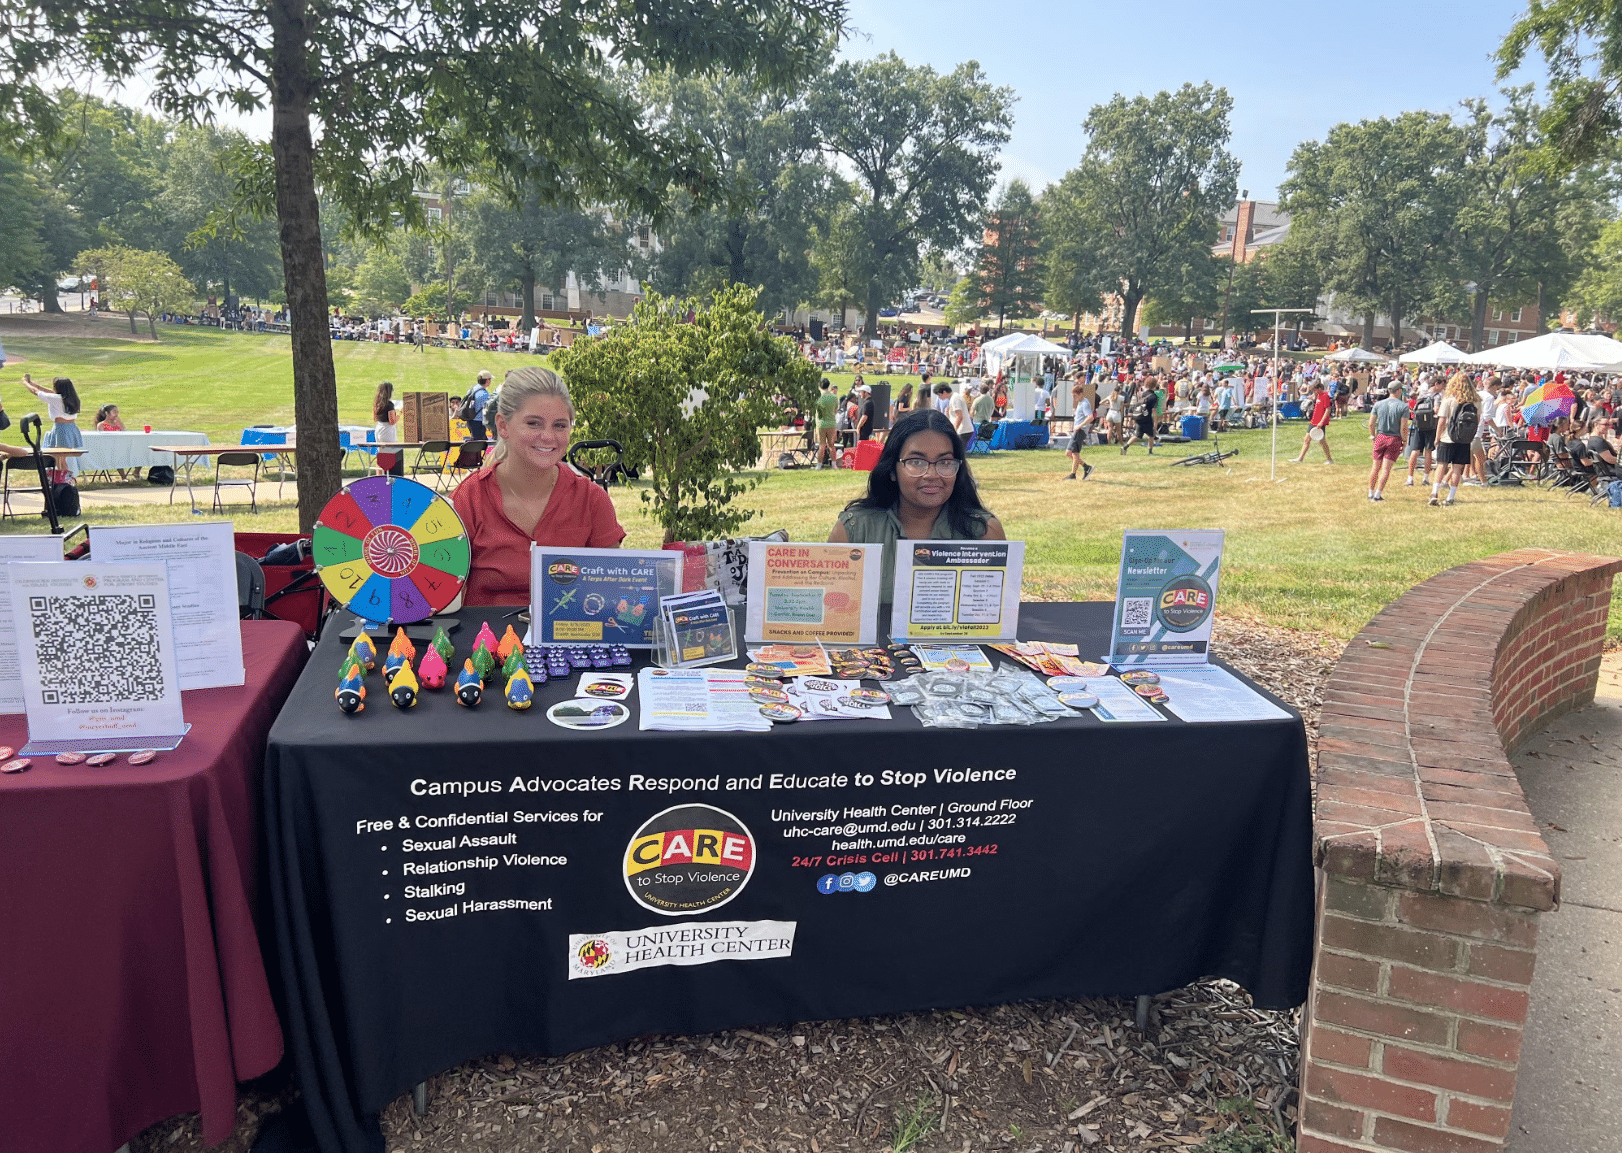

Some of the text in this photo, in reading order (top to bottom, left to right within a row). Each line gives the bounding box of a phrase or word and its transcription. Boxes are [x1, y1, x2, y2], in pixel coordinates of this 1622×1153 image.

[335, 511, 356, 528] 2
[426, 519, 443, 535] 5
[768, 548, 810, 557] CARE IN
[550, 564, 578, 573] CARE
[581, 566, 604, 574] Craft
[607, 567, 628, 575] with
[767, 559, 850, 569] CONVERSATION
[1128, 566, 1168, 575] Newsletter
[400, 590, 414, 609] 8
[1162, 590, 1208, 604] CARE
[411, 768, 1016, 797] Campus Advocates Respond and Educate to Stop Violence
[771, 809, 840, 822] University
[843, 806, 886, 819] Health
[891, 805, 936, 816] Center
[948, 800, 996, 813] Ground
[1000, 799, 1033, 810] Floor
[357, 810, 604, 834] Free & Confidential Services for
[783, 820, 916, 838] uhc-care@umd.edu
[926, 812, 1016, 829] 301.314.2222
[402, 833, 517, 852] Sexual Assault
[633, 834, 746, 864] CARE
[832, 834, 966, 850] health.umd.edu/care
[404, 854, 567, 875] Relationship Violence
[792, 855, 822, 868] 24/7
[826, 854, 867, 866] Crisis
[910, 844, 998, 861] 301.741.3442
[637, 872, 739, 886] to Stop Violence
[884, 868, 971, 886] @CAREUMD
[404, 882, 465, 898] Stalking
[644, 887, 732, 908] UNIVERSITY HEALTH CENTER
[406, 898, 552, 922] Sexual Harassment
[626, 926, 750, 949] UNIVERSITY
[625, 938, 791, 964] HEALTH CENTER
[572, 959, 616, 976] MARYLAND
